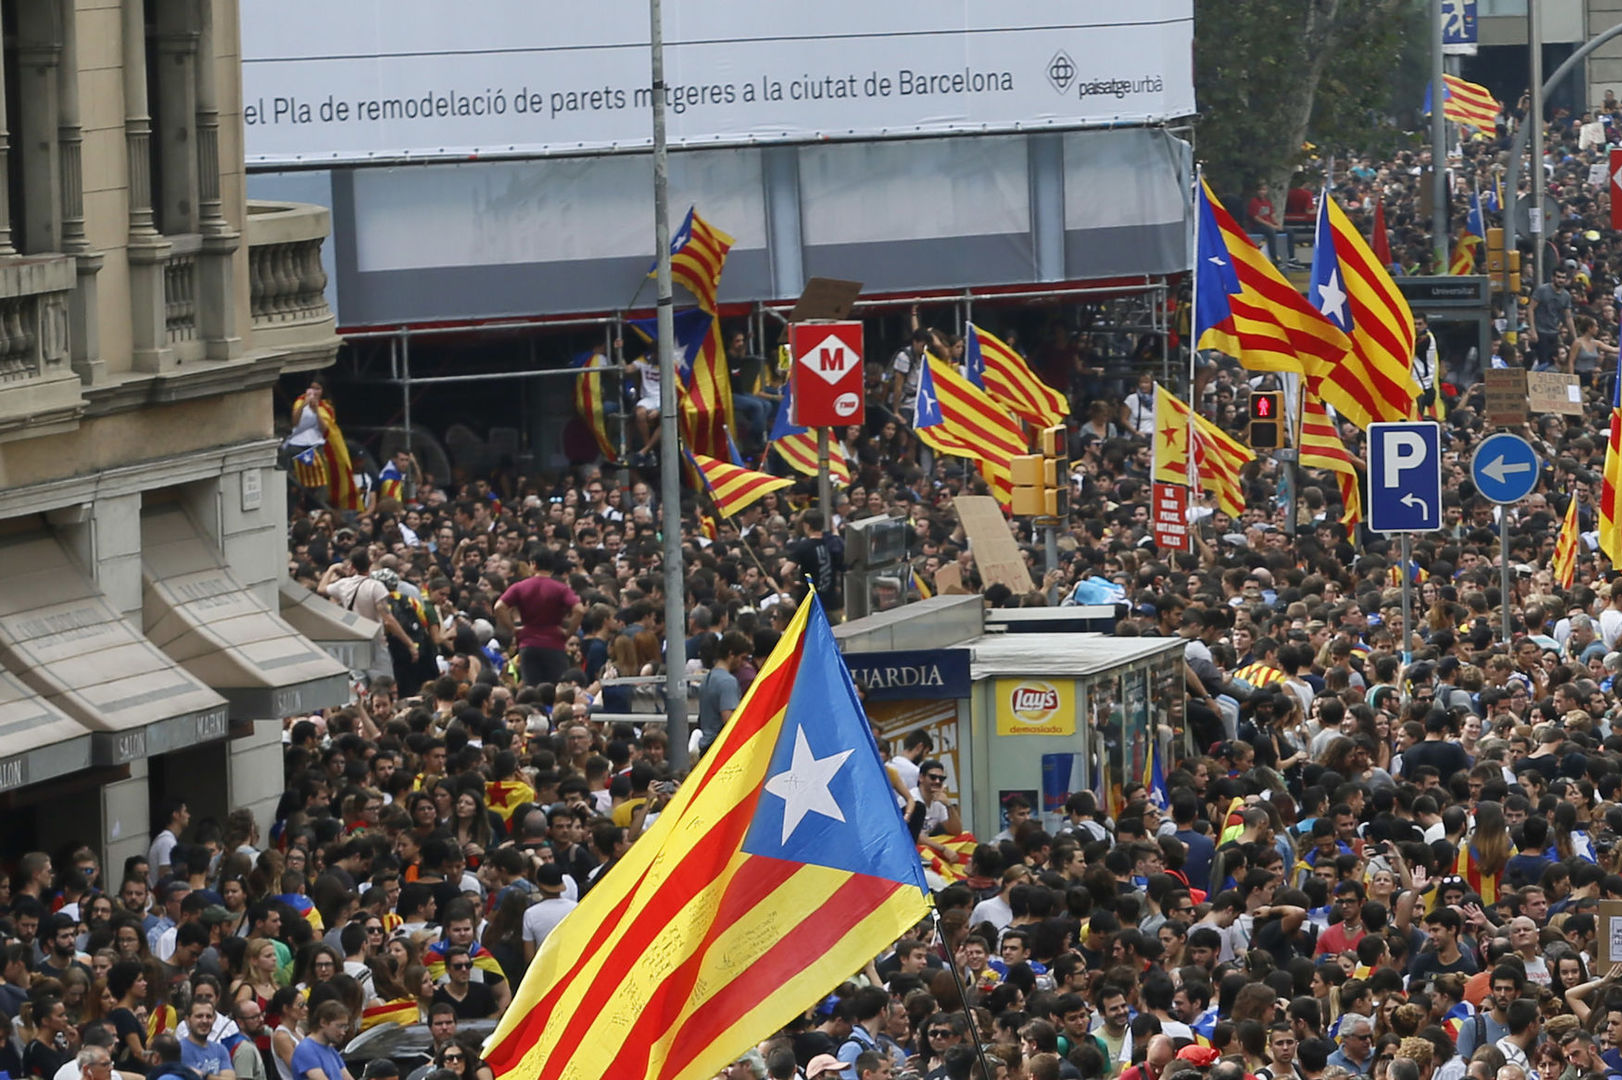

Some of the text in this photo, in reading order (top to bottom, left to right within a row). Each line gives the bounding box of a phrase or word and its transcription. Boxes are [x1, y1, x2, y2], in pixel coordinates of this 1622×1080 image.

[244, 66, 1014, 126] el Pla de remodelació de parets mtgeres a la ciutat de Barcelona
[820, 347, 844, 371] M
[1383, 431, 1427, 488] P
